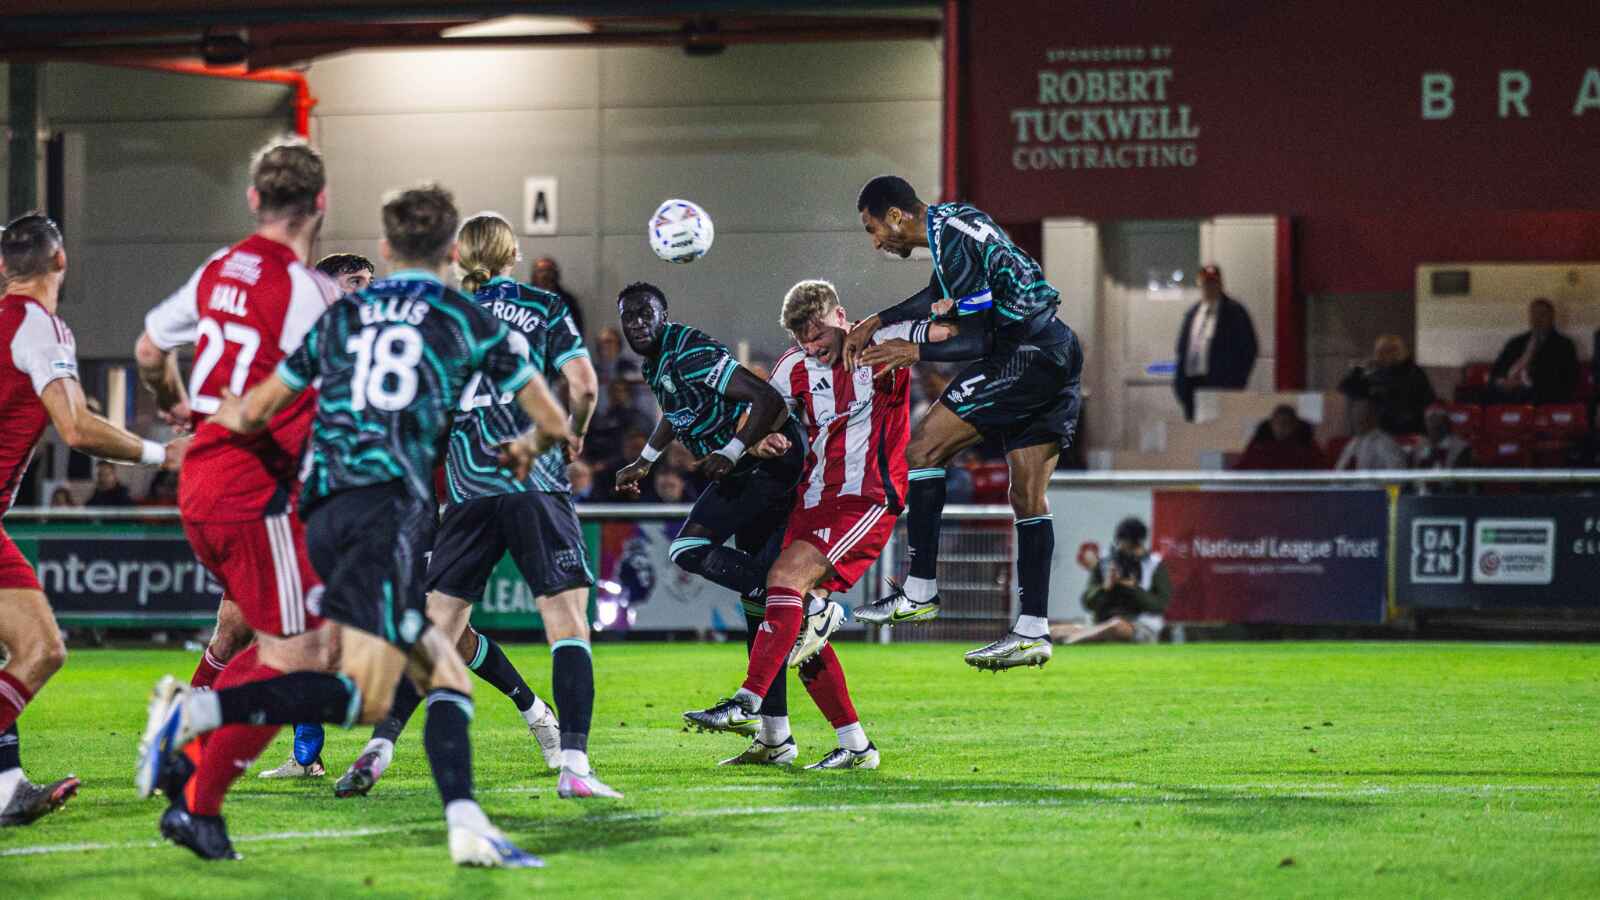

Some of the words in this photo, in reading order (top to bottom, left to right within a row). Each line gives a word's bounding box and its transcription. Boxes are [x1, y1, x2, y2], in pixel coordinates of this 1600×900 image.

[1038, 68, 1173, 103] ROBERT
[1011, 104, 1200, 142] TUCKWELL
[1012, 144, 1198, 170] CONTRACTING
[532, 190, 549, 224] A
[360, 297, 430, 326] ELLIS
[189, 317, 261, 415] 27
[346, 325, 424, 412] 18
[1193, 537, 1265, 557] National
[1269, 537, 1331, 562] League
[1335, 535, 1379, 557] Trust
[38, 553, 226, 605] nterpris
[483, 579, 537, 612] LEA
